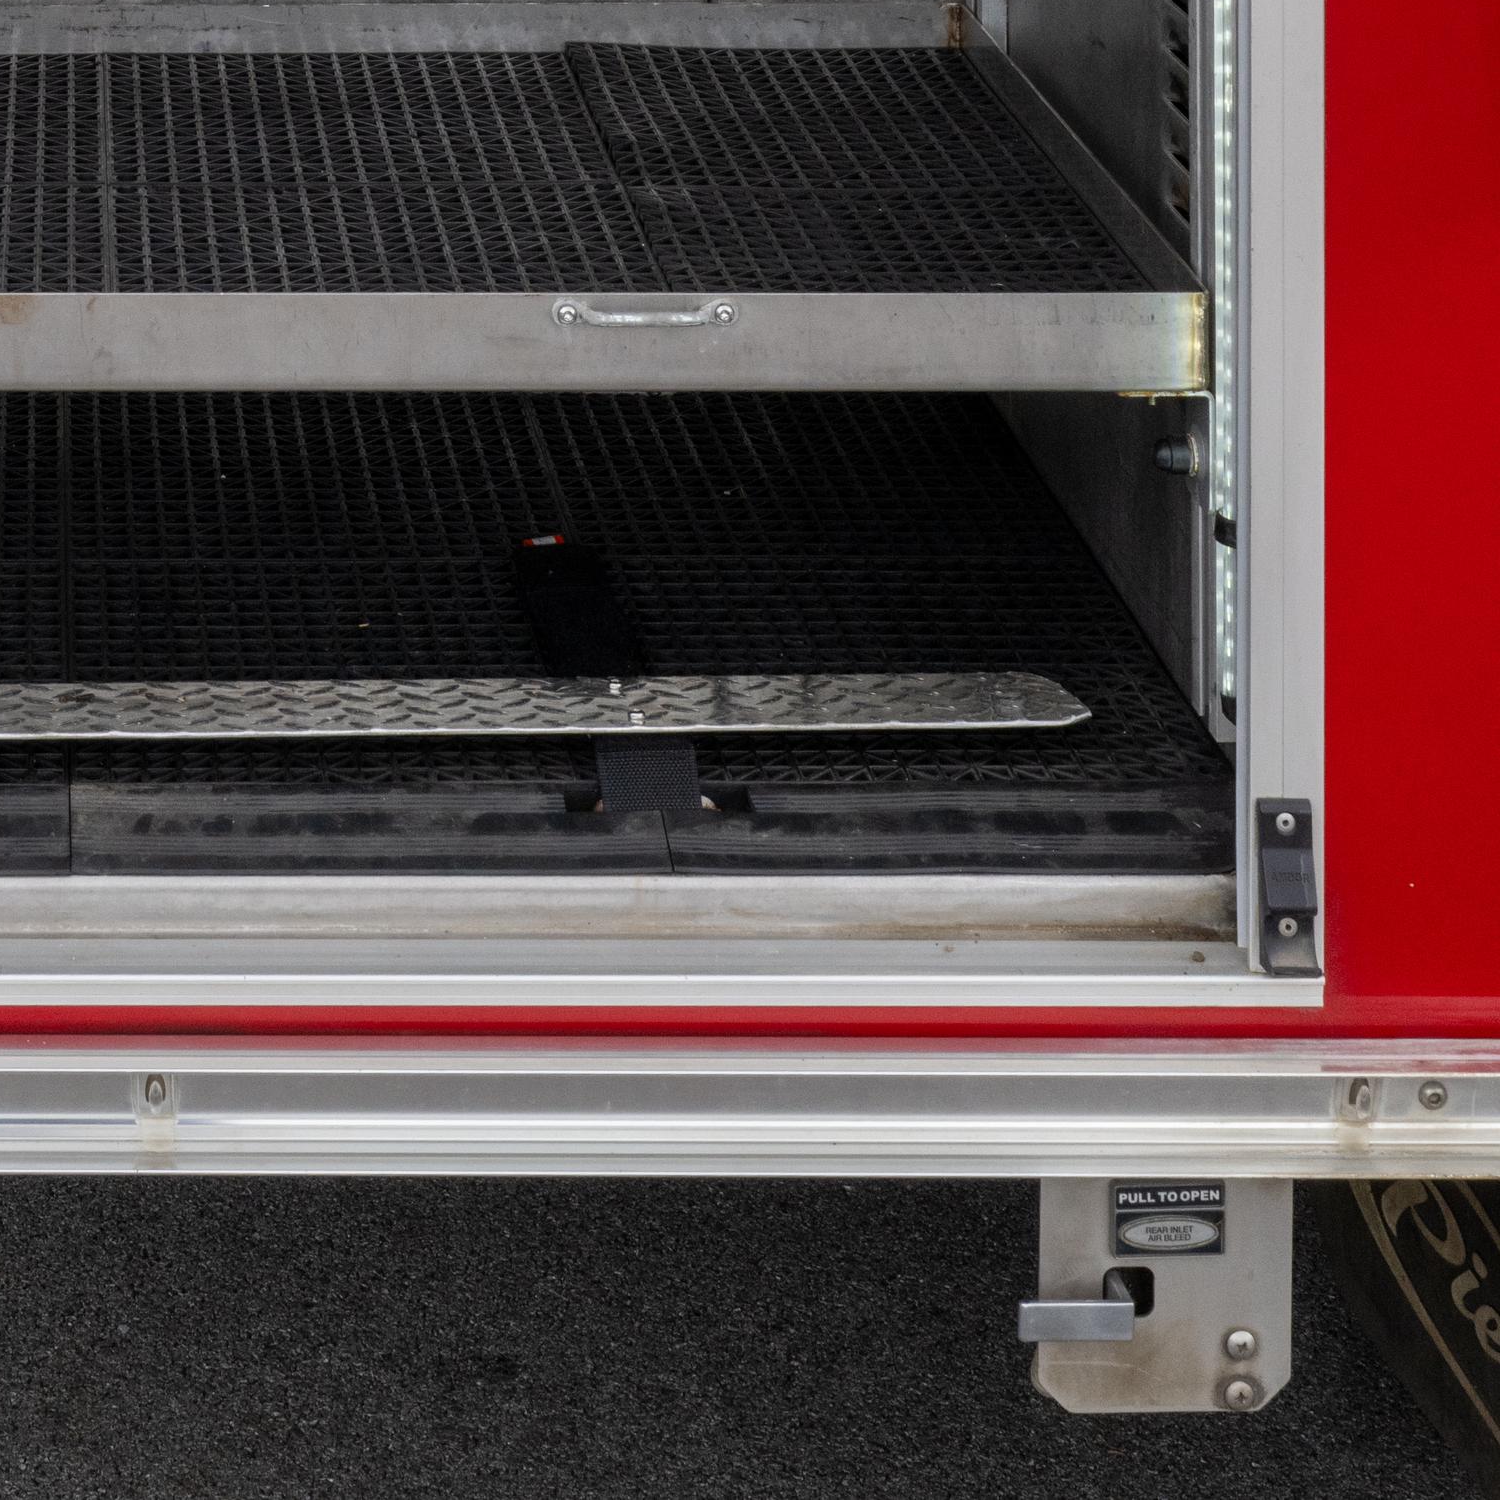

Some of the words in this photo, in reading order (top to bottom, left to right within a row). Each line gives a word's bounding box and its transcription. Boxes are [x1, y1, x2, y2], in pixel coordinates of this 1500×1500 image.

[1118, 1192, 1155, 1204] PULL
[1157, 1191, 1178, 1203] TO
[1180, 1189, 1220, 1202] OPEN
[1145, 1226, 1168, 1234] REAR
[1170, 1225, 1193, 1233] INLET
[1148, 1234, 1162, 1242] AIR
[1164, 1233, 1191, 1241] BLEED
